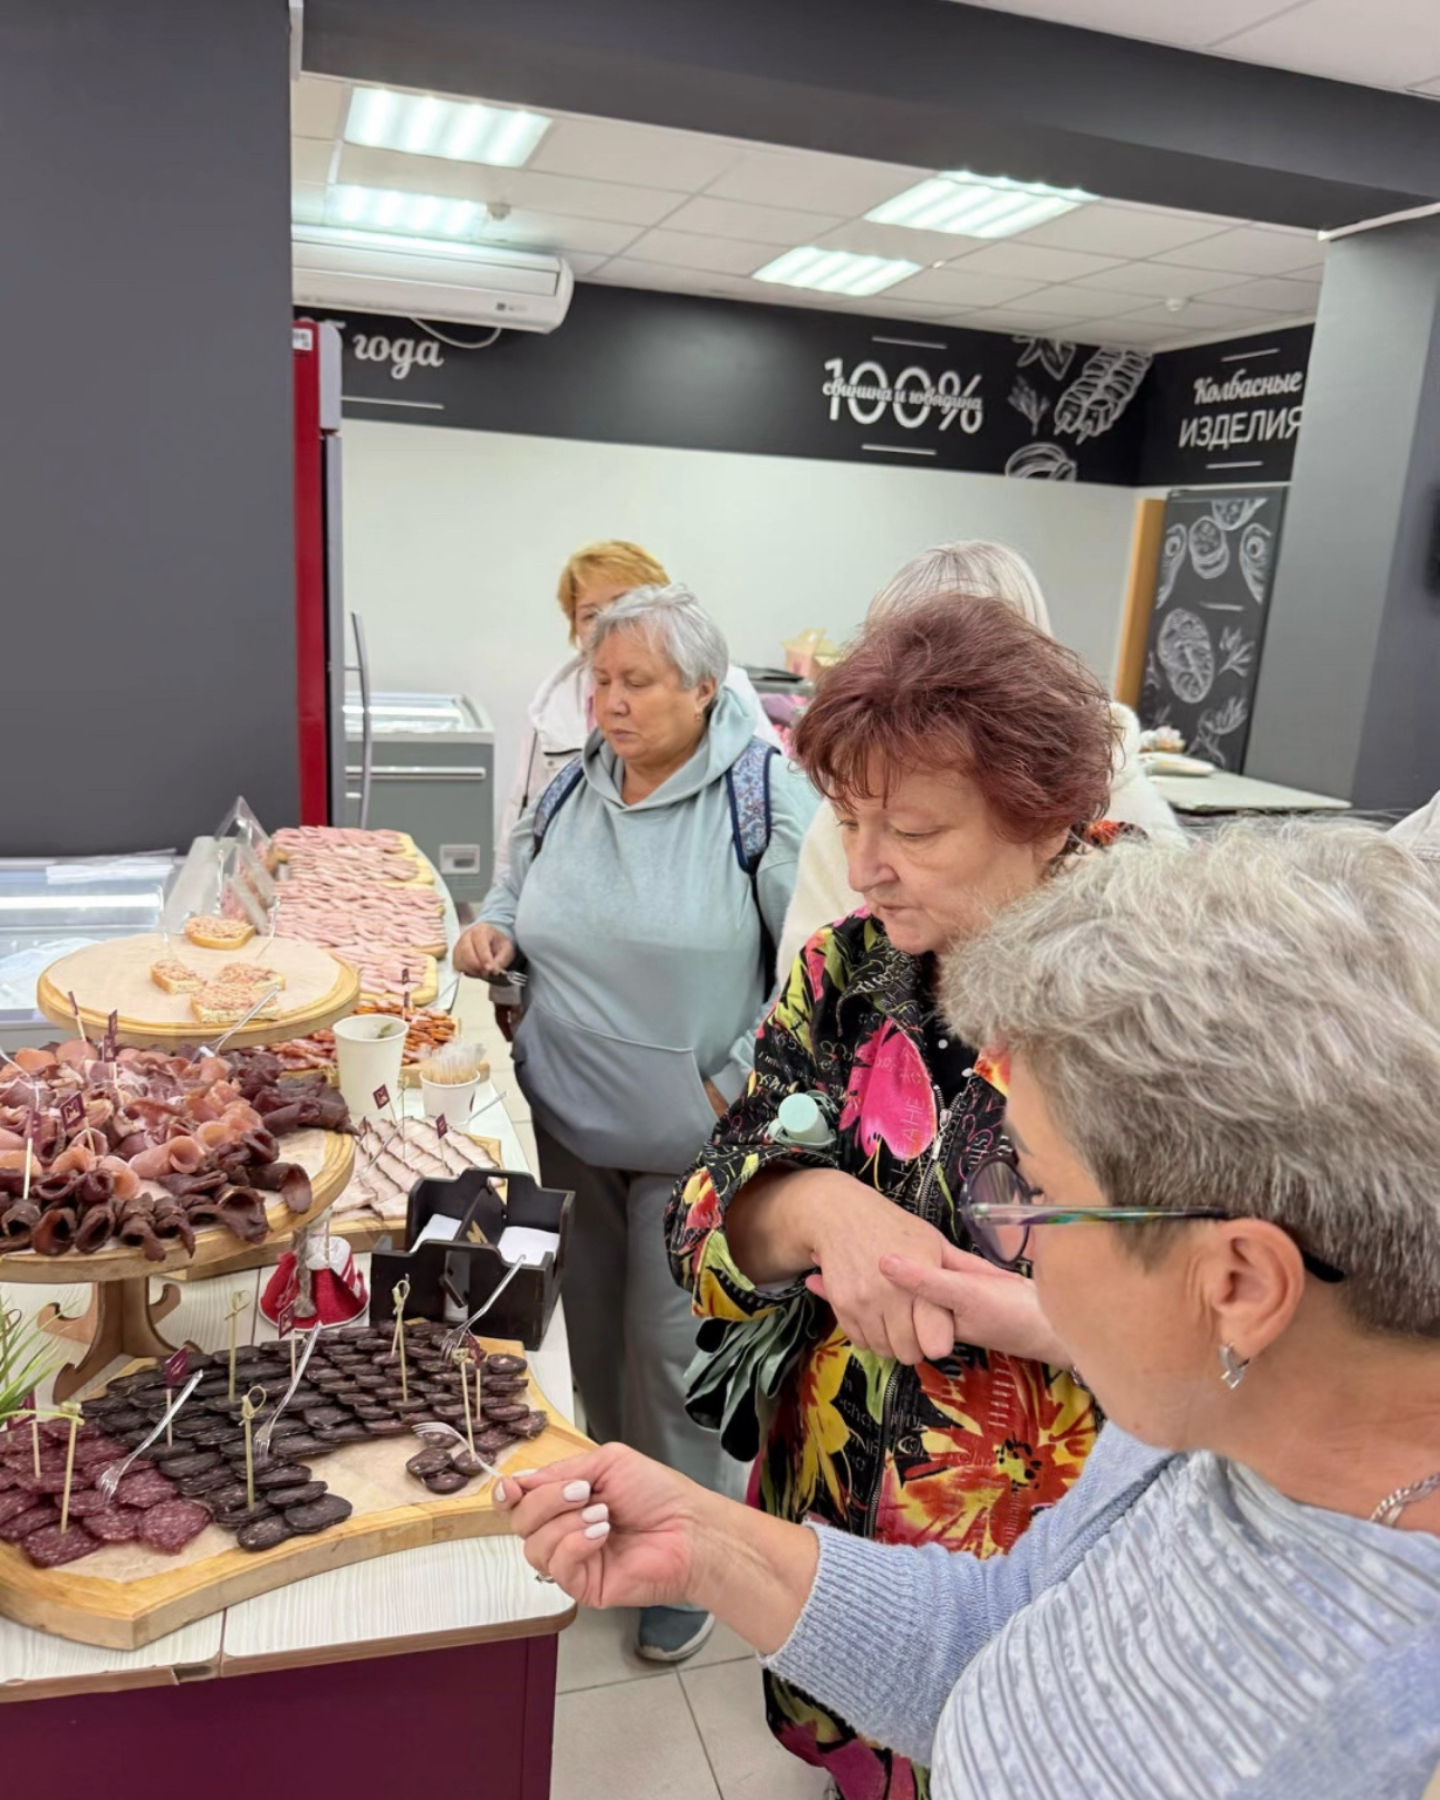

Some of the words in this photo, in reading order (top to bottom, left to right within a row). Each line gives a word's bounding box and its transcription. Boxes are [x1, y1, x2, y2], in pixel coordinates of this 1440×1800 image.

[353, 334, 444, 379] года
[823, 357, 984, 434] 100%
[1193, 368, 1303, 405] Колбасные
[1178, 405, 1305, 451] ИЗДЕЛИЯ
